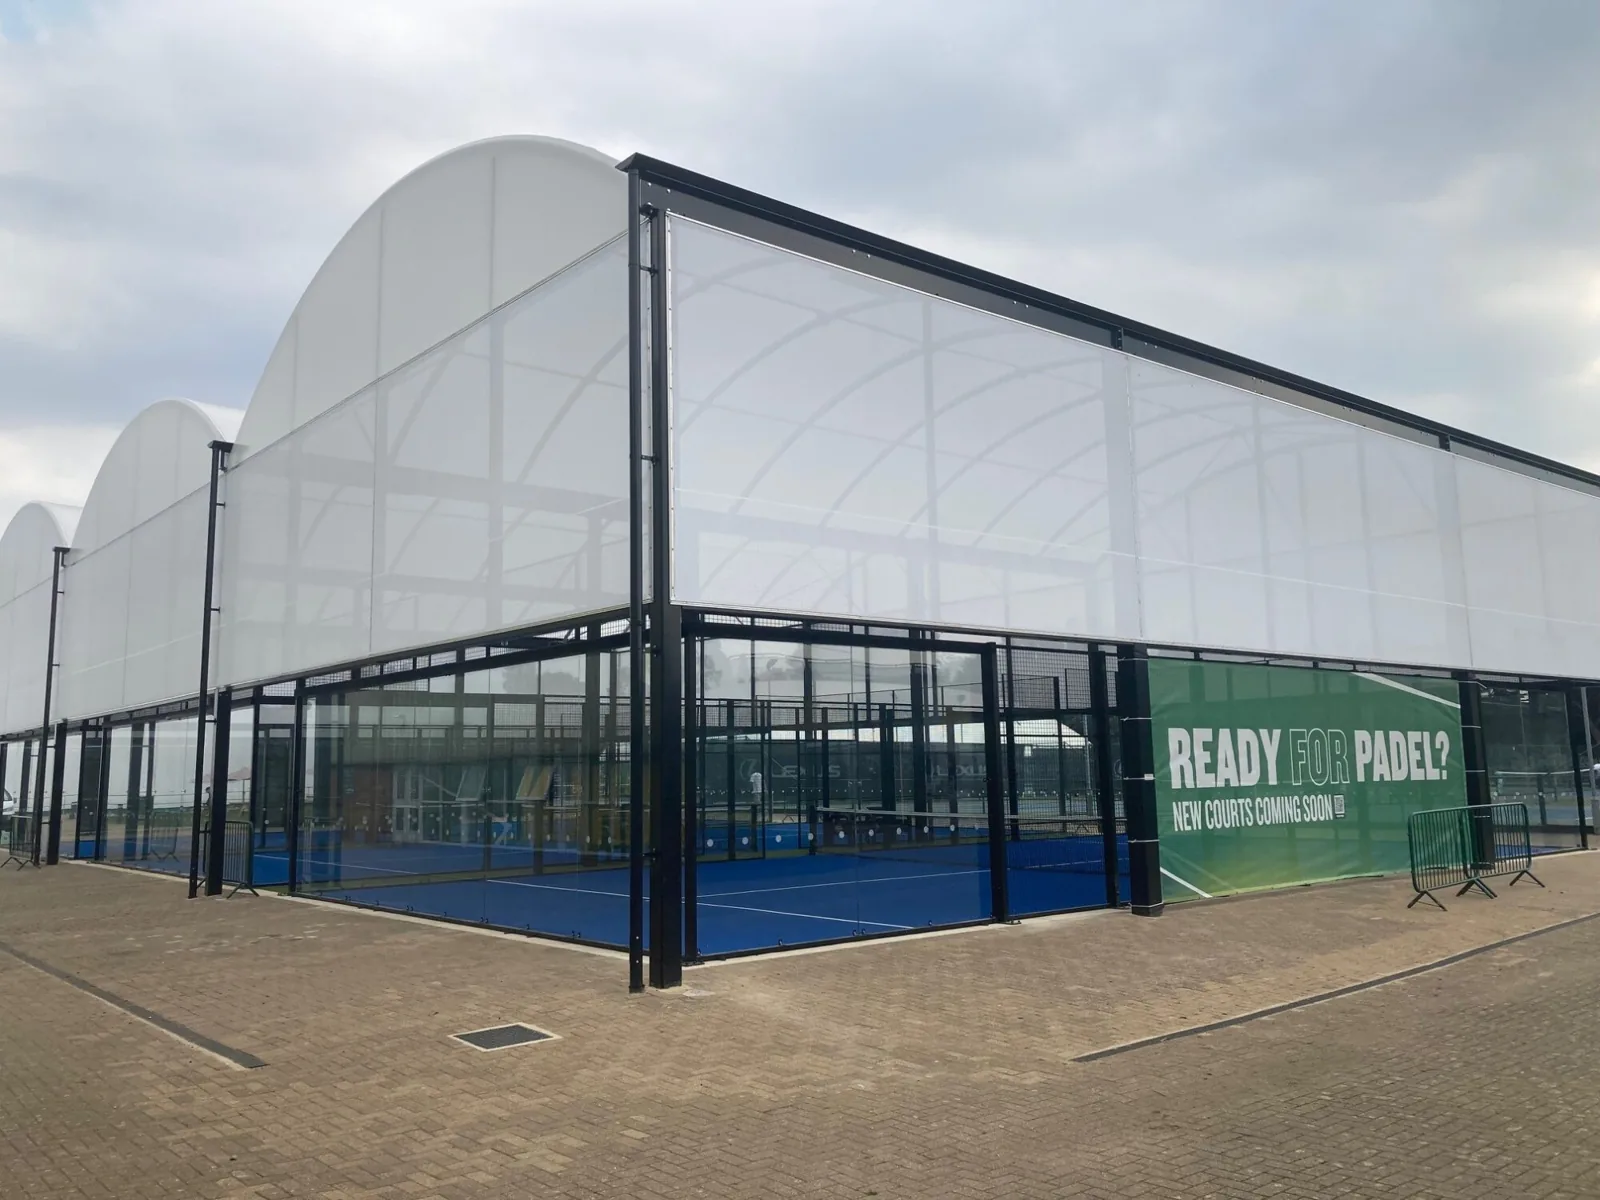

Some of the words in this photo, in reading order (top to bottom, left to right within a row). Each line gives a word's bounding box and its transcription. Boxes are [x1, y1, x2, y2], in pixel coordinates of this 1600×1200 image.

[1168, 727, 1281, 789] READY
[1289, 728, 1350, 786] FOR
[1354, 730, 1450, 782] PADEL?
[1172, 801, 1202, 832] NEW
[1204, 798, 1254, 830] COURTS
[1255, 795, 1301, 826] COMING
[1302, 794, 1334, 822] SOON
